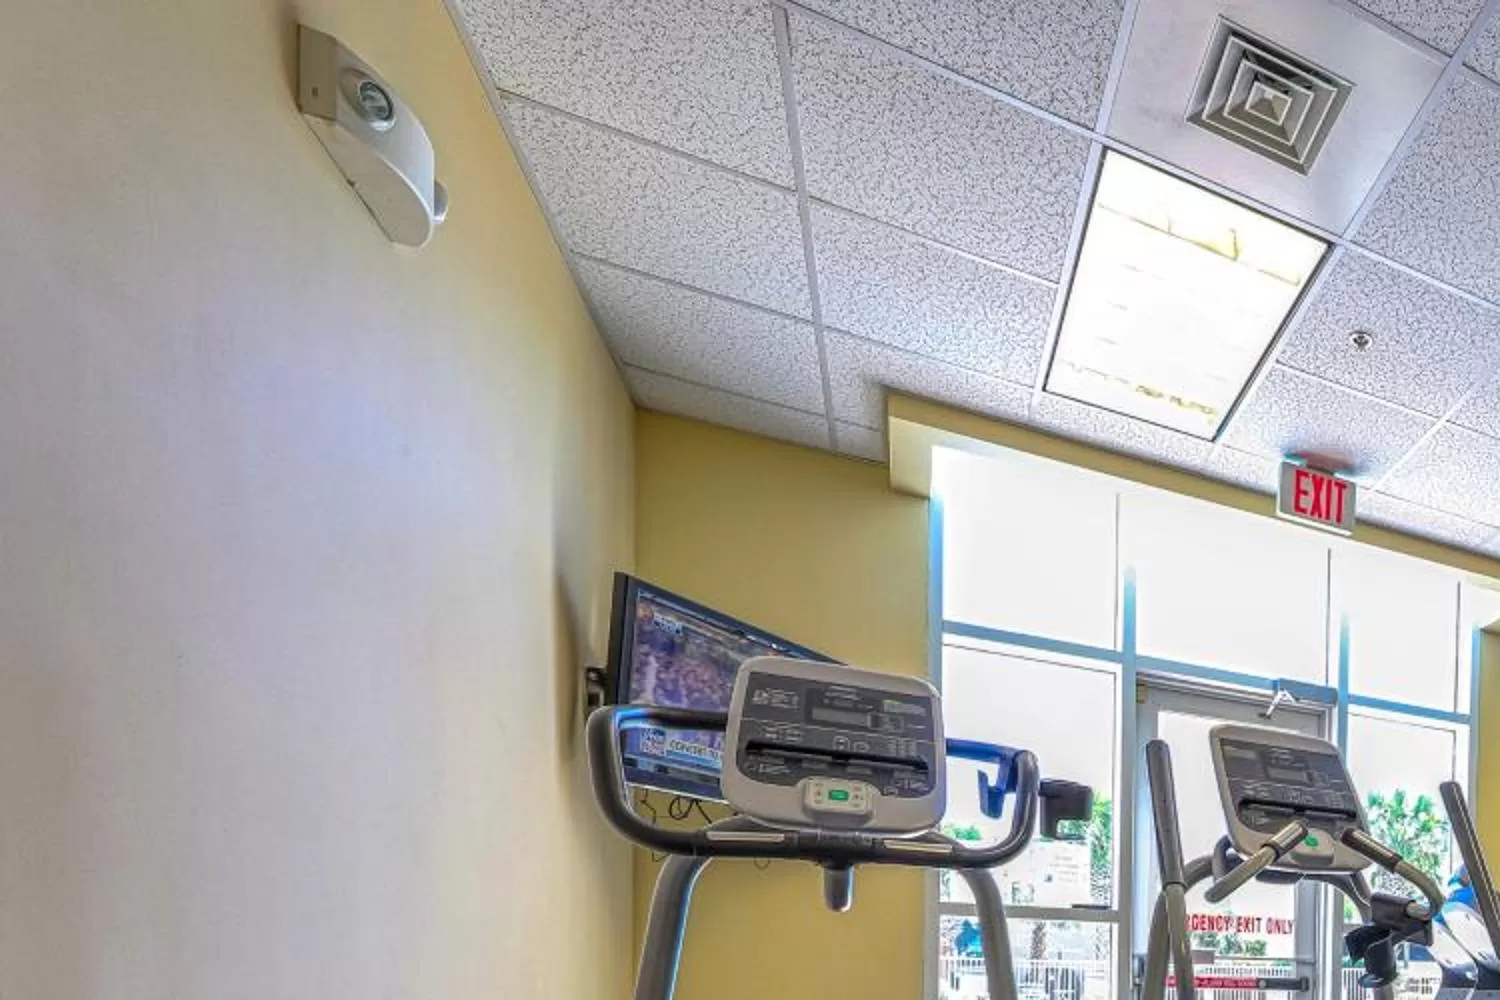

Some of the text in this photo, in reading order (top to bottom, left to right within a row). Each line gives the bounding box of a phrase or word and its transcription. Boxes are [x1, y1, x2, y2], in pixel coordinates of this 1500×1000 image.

[1293, 469, 1347, 524] EXIT
[1235, 915, 1262, 933] EXIT
[1266, 918, 1294, 935] ONLY
